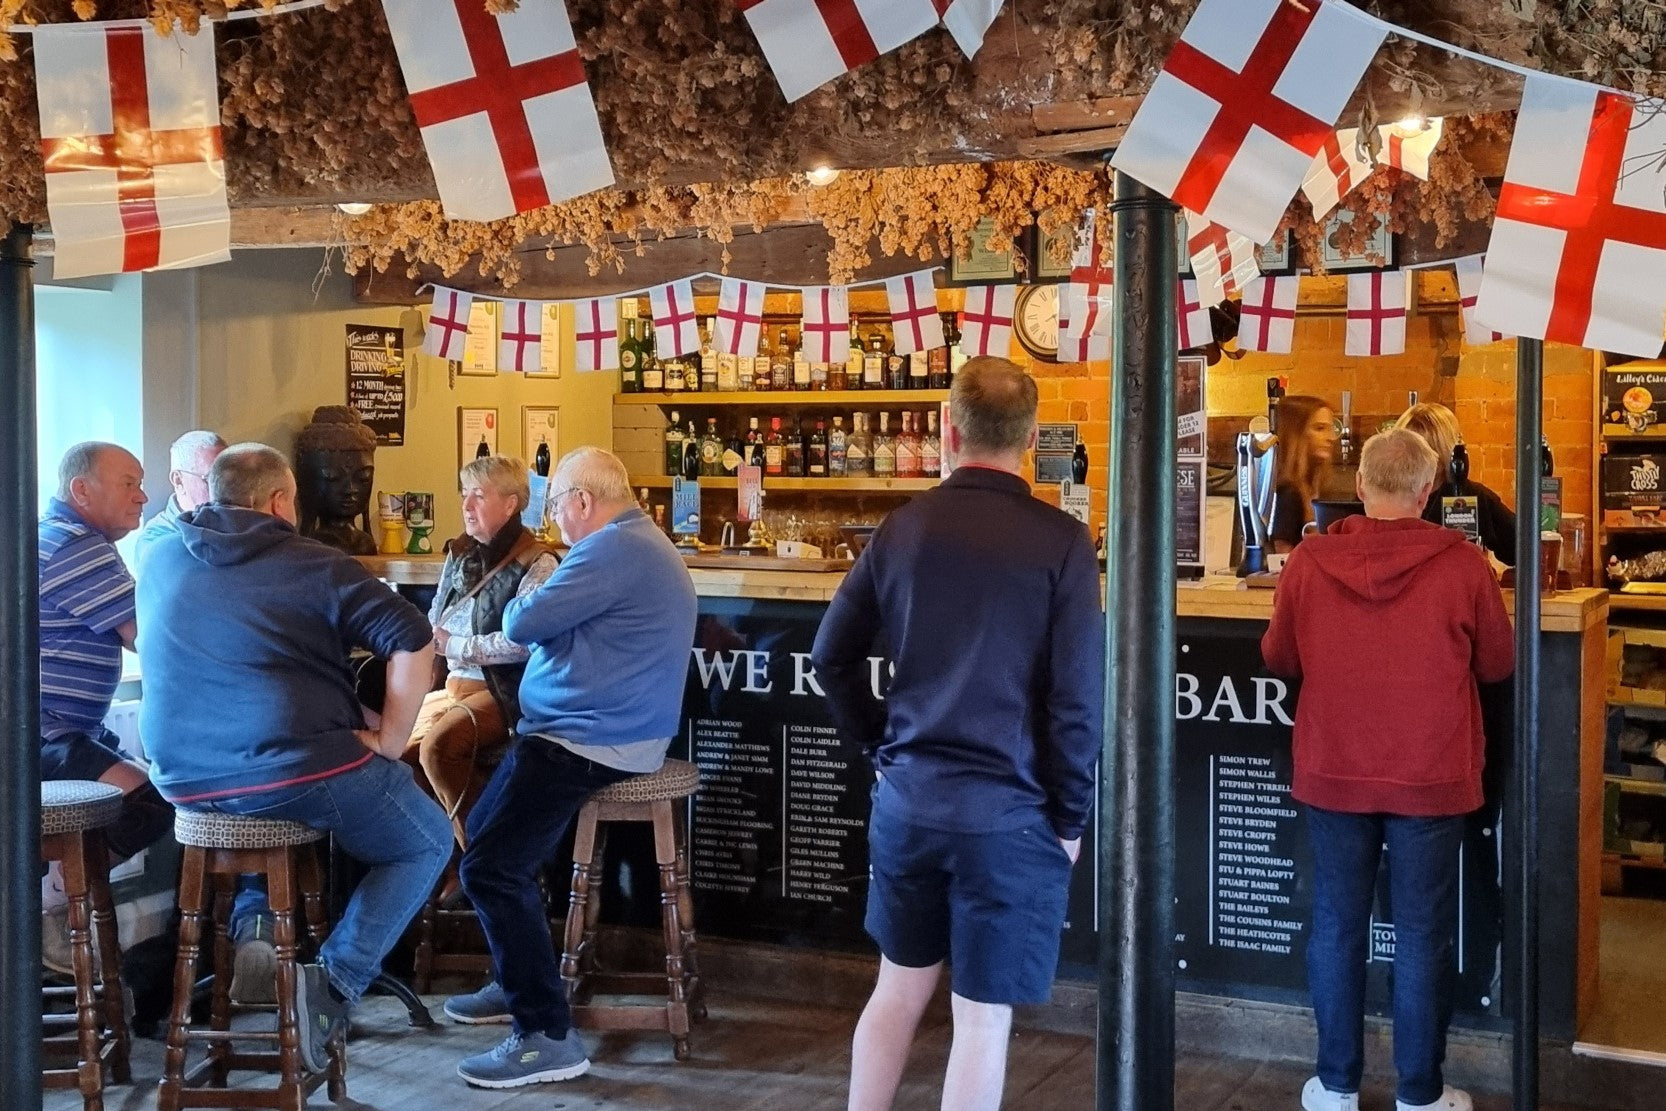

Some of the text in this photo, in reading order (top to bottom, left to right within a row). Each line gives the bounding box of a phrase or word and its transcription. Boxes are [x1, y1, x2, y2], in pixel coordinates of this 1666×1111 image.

[350, 350, 387, 363] DRINKING
[350, 360, 383, 373] DRIVING
[356, 380, 363, 390] 12
[364, 380, 384, 391] MONTH
[358, 400, 374, 409] FREE
[1631, 479, 1658, 490] CROSS
[691, 647, 773, 693] WE
[1176, 673, 1295, 726] BAR
[697, 719, 742, 728] ADRIAN WOOD
[791, 725, 811, 733] COLIN
[697, 741, 733, 749] ALEXANDER
[791, 736, 841, 746] COLIN LAIDLER
[809, 748, 827, 756] BURR
[806, 759, 847, 769] FITZGERALD
[1219, 755, 1270, 765] SIMON TREW
[697, 762, 724, 770] ANDREW
[809, 770, 835, 779] WILSON
[1219, 768, 1276, 778] SIMON WALLIS
[812, 782, 846, 792] MIDDLING
[1219, 780, 1292, 792] STEPHEN TYRRELL
[812, 794, 838, 802] BRYDEN
[1219, 792, 1281, 803] STEPHEN WILES
[812, 804, 834, 813] GRACE
[1219, 804, 1297, 817] STEVE BLOOMFIELD
[829, 817, 864, 827] REYNOLDS
[1219, 816, 1277, 828] STEVE BRYDEN
[790, 825, 848, 837] GARETH ROBERTS
[1219, 829, 1276, 840] STEVE CROFTS
[790, 836, 811, 844] GEOFF
[1219, 841, 1270, 852] STEVE HOWE
[810, 849, 839, 858] MULLINS
[790, 859, 844, 870] GREEN MACHINE
[1219, 854, 1293, 867] STEVE WOODHEAD
[813, 871, 831, 879] WILD
[1219, 865, 1234, 873] STU
[1243, 868, 1266, 877] PIPPA
[1267, 870, 1295, 880] LOFTY
[790, 881, 849, 893] HENRY FERGUSON
[1219, 878, 1279, 890] STUART BAINES
[802, 893, 832, 902] CHURCH
[1219, 890, 1290, 904] STUART BOULTON
[1219, 902, 1269, 914] THE BAILEYS
[1219, 914, 1303, 930] THE COUSINS FAMILY
[1219, 926, 1291, 941] THE HEATHCOTES
[1219, 938, 1291, 954] THE ISAAC FAMILY
